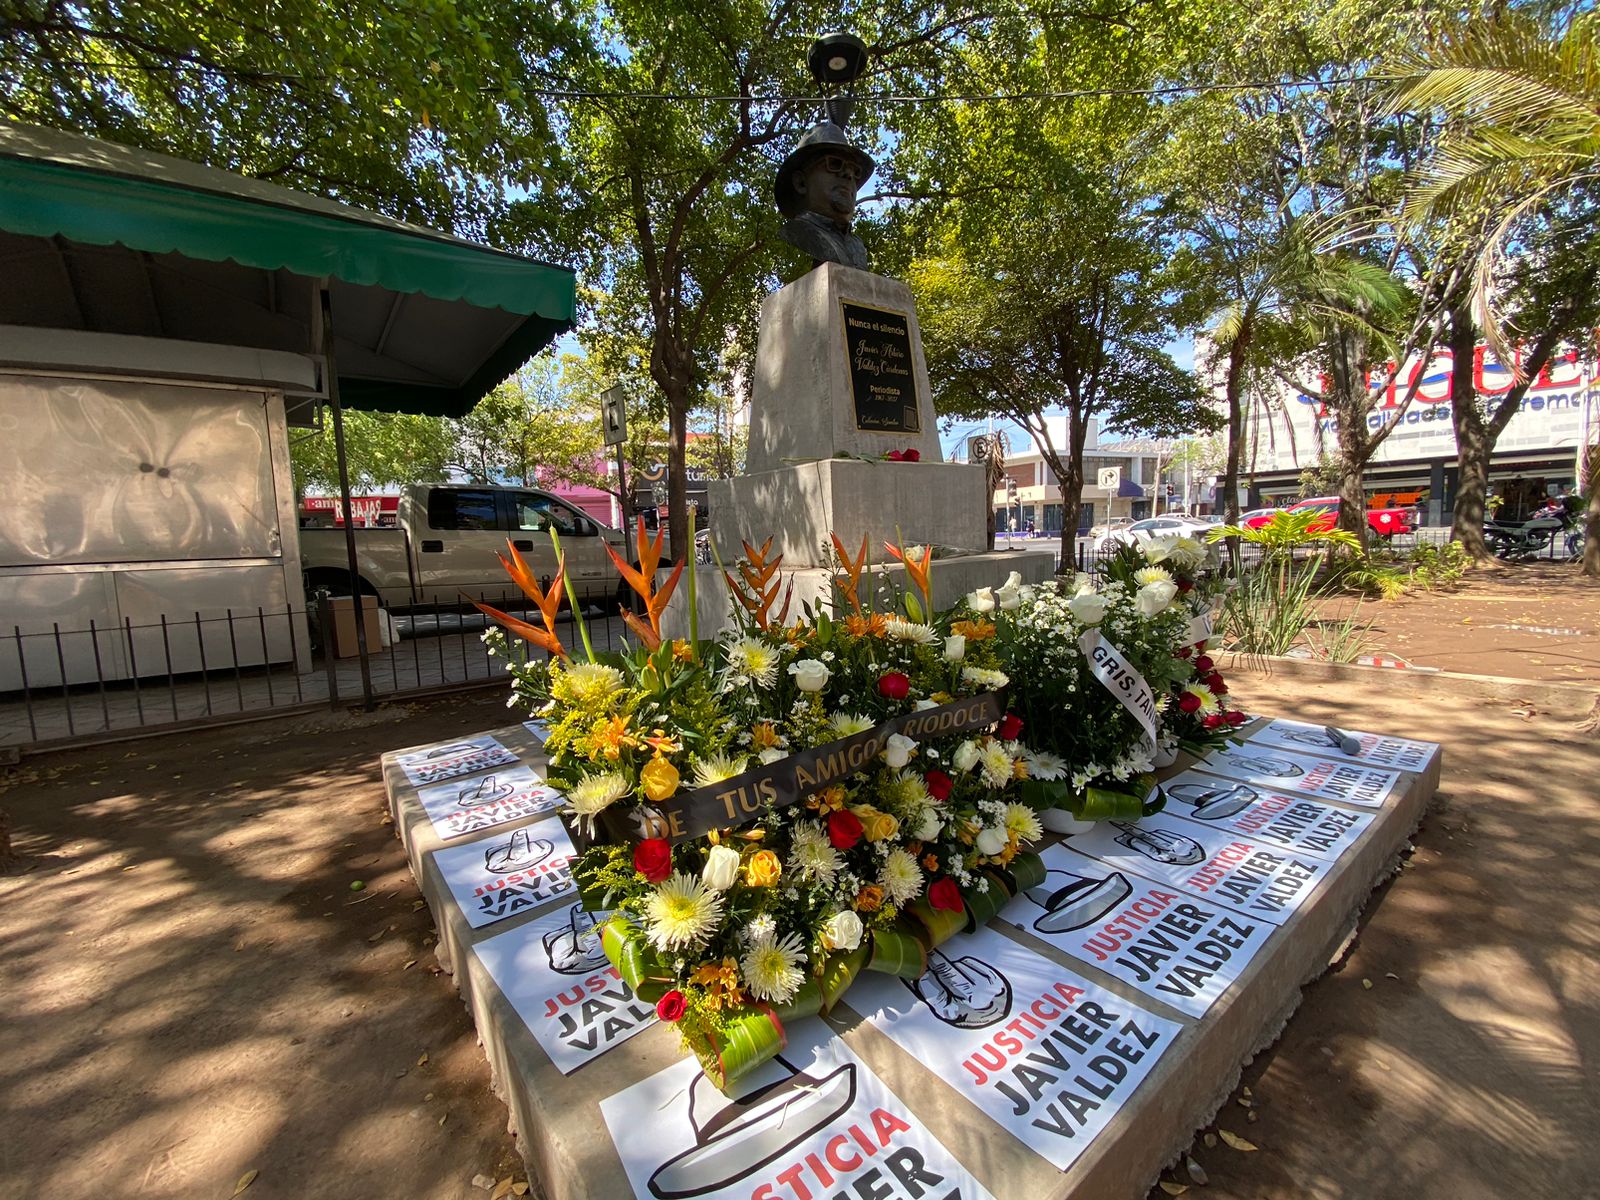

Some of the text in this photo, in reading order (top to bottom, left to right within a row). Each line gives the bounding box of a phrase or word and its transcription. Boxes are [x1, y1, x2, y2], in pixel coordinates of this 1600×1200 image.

[848, 317, 905, 337] Nunca el silencio
[870, 385, 901, 396] Periodista
[335, 500, 382, 519] RBAJAS
[1092, 646, 1136, 698] GRIS,
[415, 749, 504, 773] JUSTICIA
[418, 753, 504, 778] JAVIER
[419, 758, 509, 782] VALDEZ
[644, 809, 688, 840] DE
[716, 777, 778, 820] TUS
[903, 702, 988, 737] RIODOCE
[1297, 762, 1339, 792] JUSTICIA
[1321, 766, 1364, 798] JAVIER
[447, 790, 545, 821] JUSTICIA
[1351, 771, 1391, 801] VALDEZ
[448, 796, 546, 829] JAVIER
[451, 801, 554, 833] VALDEZ
[1232, 795, 1296, 834] JUSTICIA
[1261, 803, 1327, 844] JAVIER
[1296, 810, 1360, 854] VALDEZ
[472, 854, 574, 898] JUSTICI
[478, 866, 572, 910] JAVIE
[1186, 842, 1256, 892] JUSTICIA
[1214, 851, 1286, 905] JAVIER
[1249, 860, 1320, 915] VALDEZ
[482, 882, 572, 917] VALD
[1081, 888, 1179, 961] JUSTICIA
[1114, 902, 1216, 983] JAVIER
[1155, 916, 1256, 998] VALDEZ
[544, 966, 622, 1018] JUST
[558, 981, 633, 1039] JAV
[567, 1004, 656, 1051] VAL
[961, 981, 1086, 1086] JUSTICIA
[994, 1000, 1120, 1117] JAVIER
[1031, 1020, 1161, 1140] VALDEZ
[751, 1107, 911, 1200] STICIA
